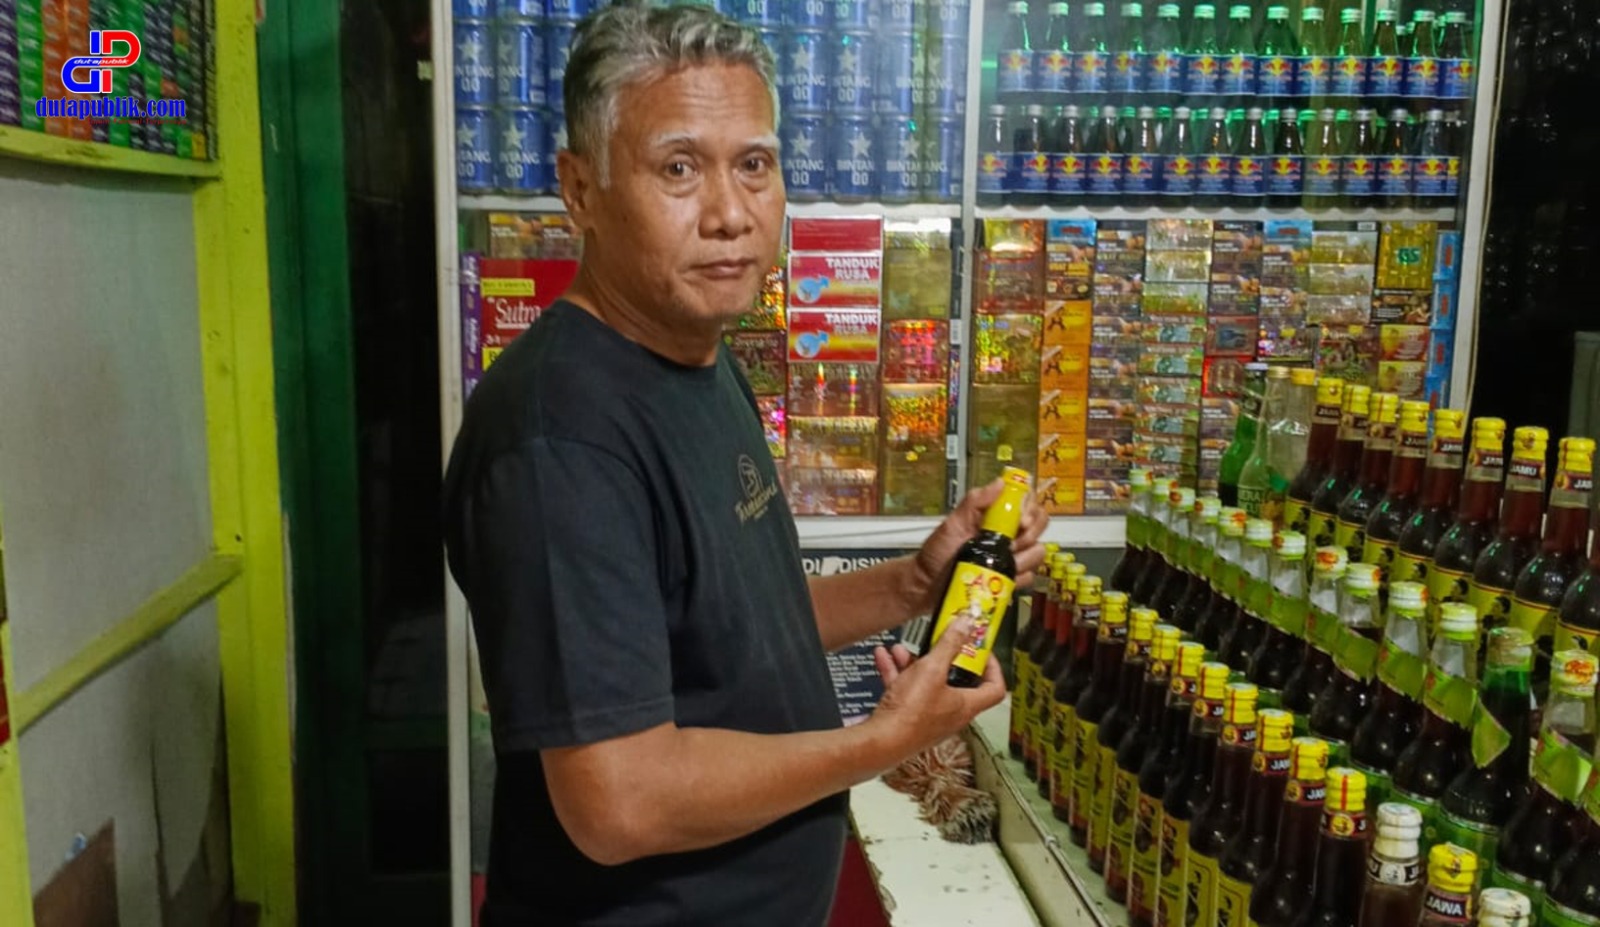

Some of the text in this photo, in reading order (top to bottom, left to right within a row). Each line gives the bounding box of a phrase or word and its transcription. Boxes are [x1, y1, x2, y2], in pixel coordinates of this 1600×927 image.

[791, 171, 810, 186] 00
[851, 171, 870, 186] 00
[825, 256, 880, 270] TANDUK
[834, 268, 870, 281] RUSA
[823, 312, 878, 326] TANDUK
[1426, 896, 1463, 916] JAWA
